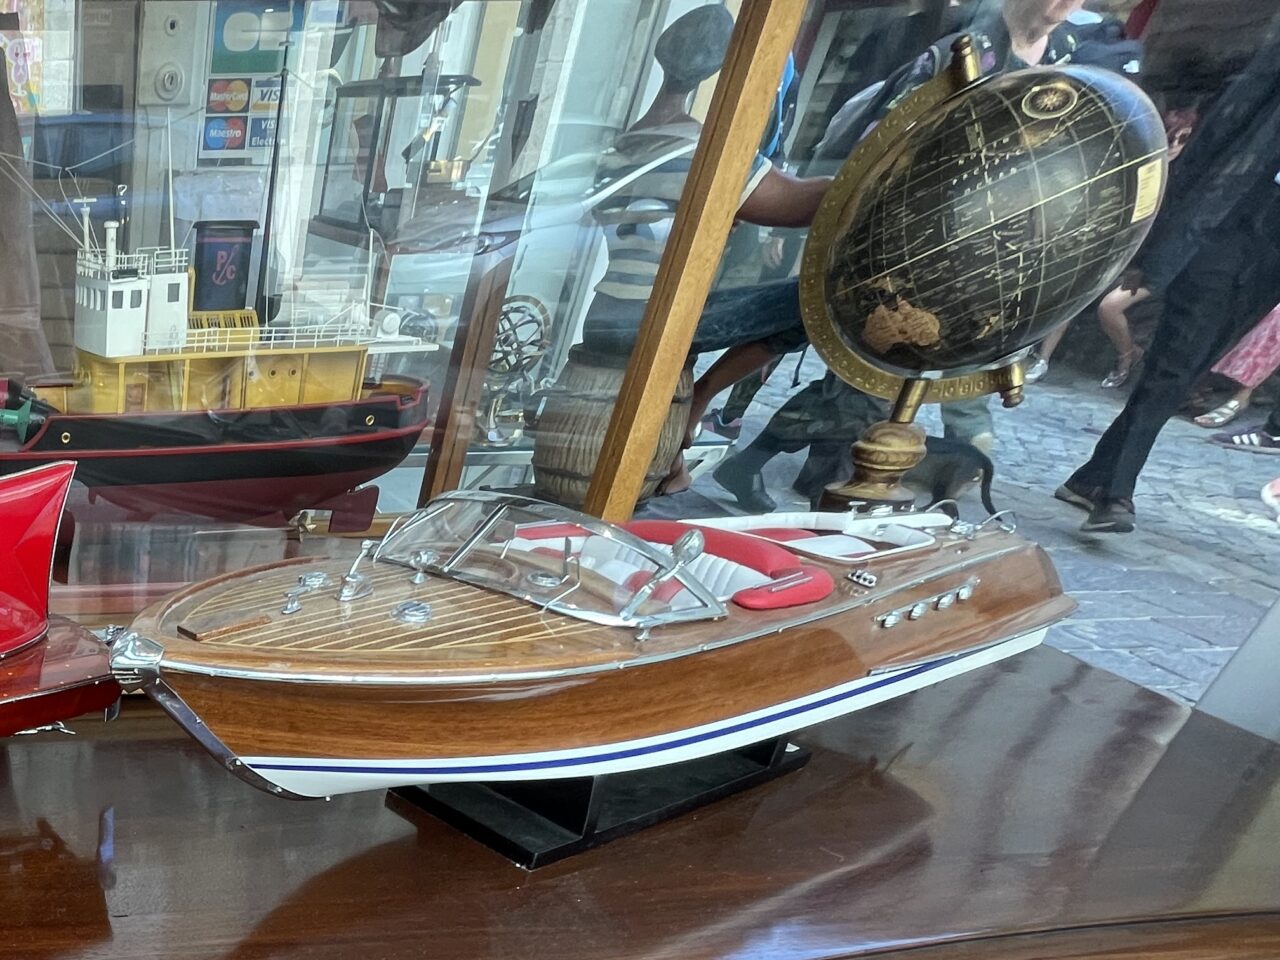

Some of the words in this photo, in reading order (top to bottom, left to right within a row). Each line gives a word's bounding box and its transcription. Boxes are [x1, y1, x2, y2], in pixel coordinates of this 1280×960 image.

[260, 89, 280, 102] VIS
[261, 119, 276, 130] VIS
[209, 129, 242, 138] Maestro
[251, 136, 286, 146] Electrn
